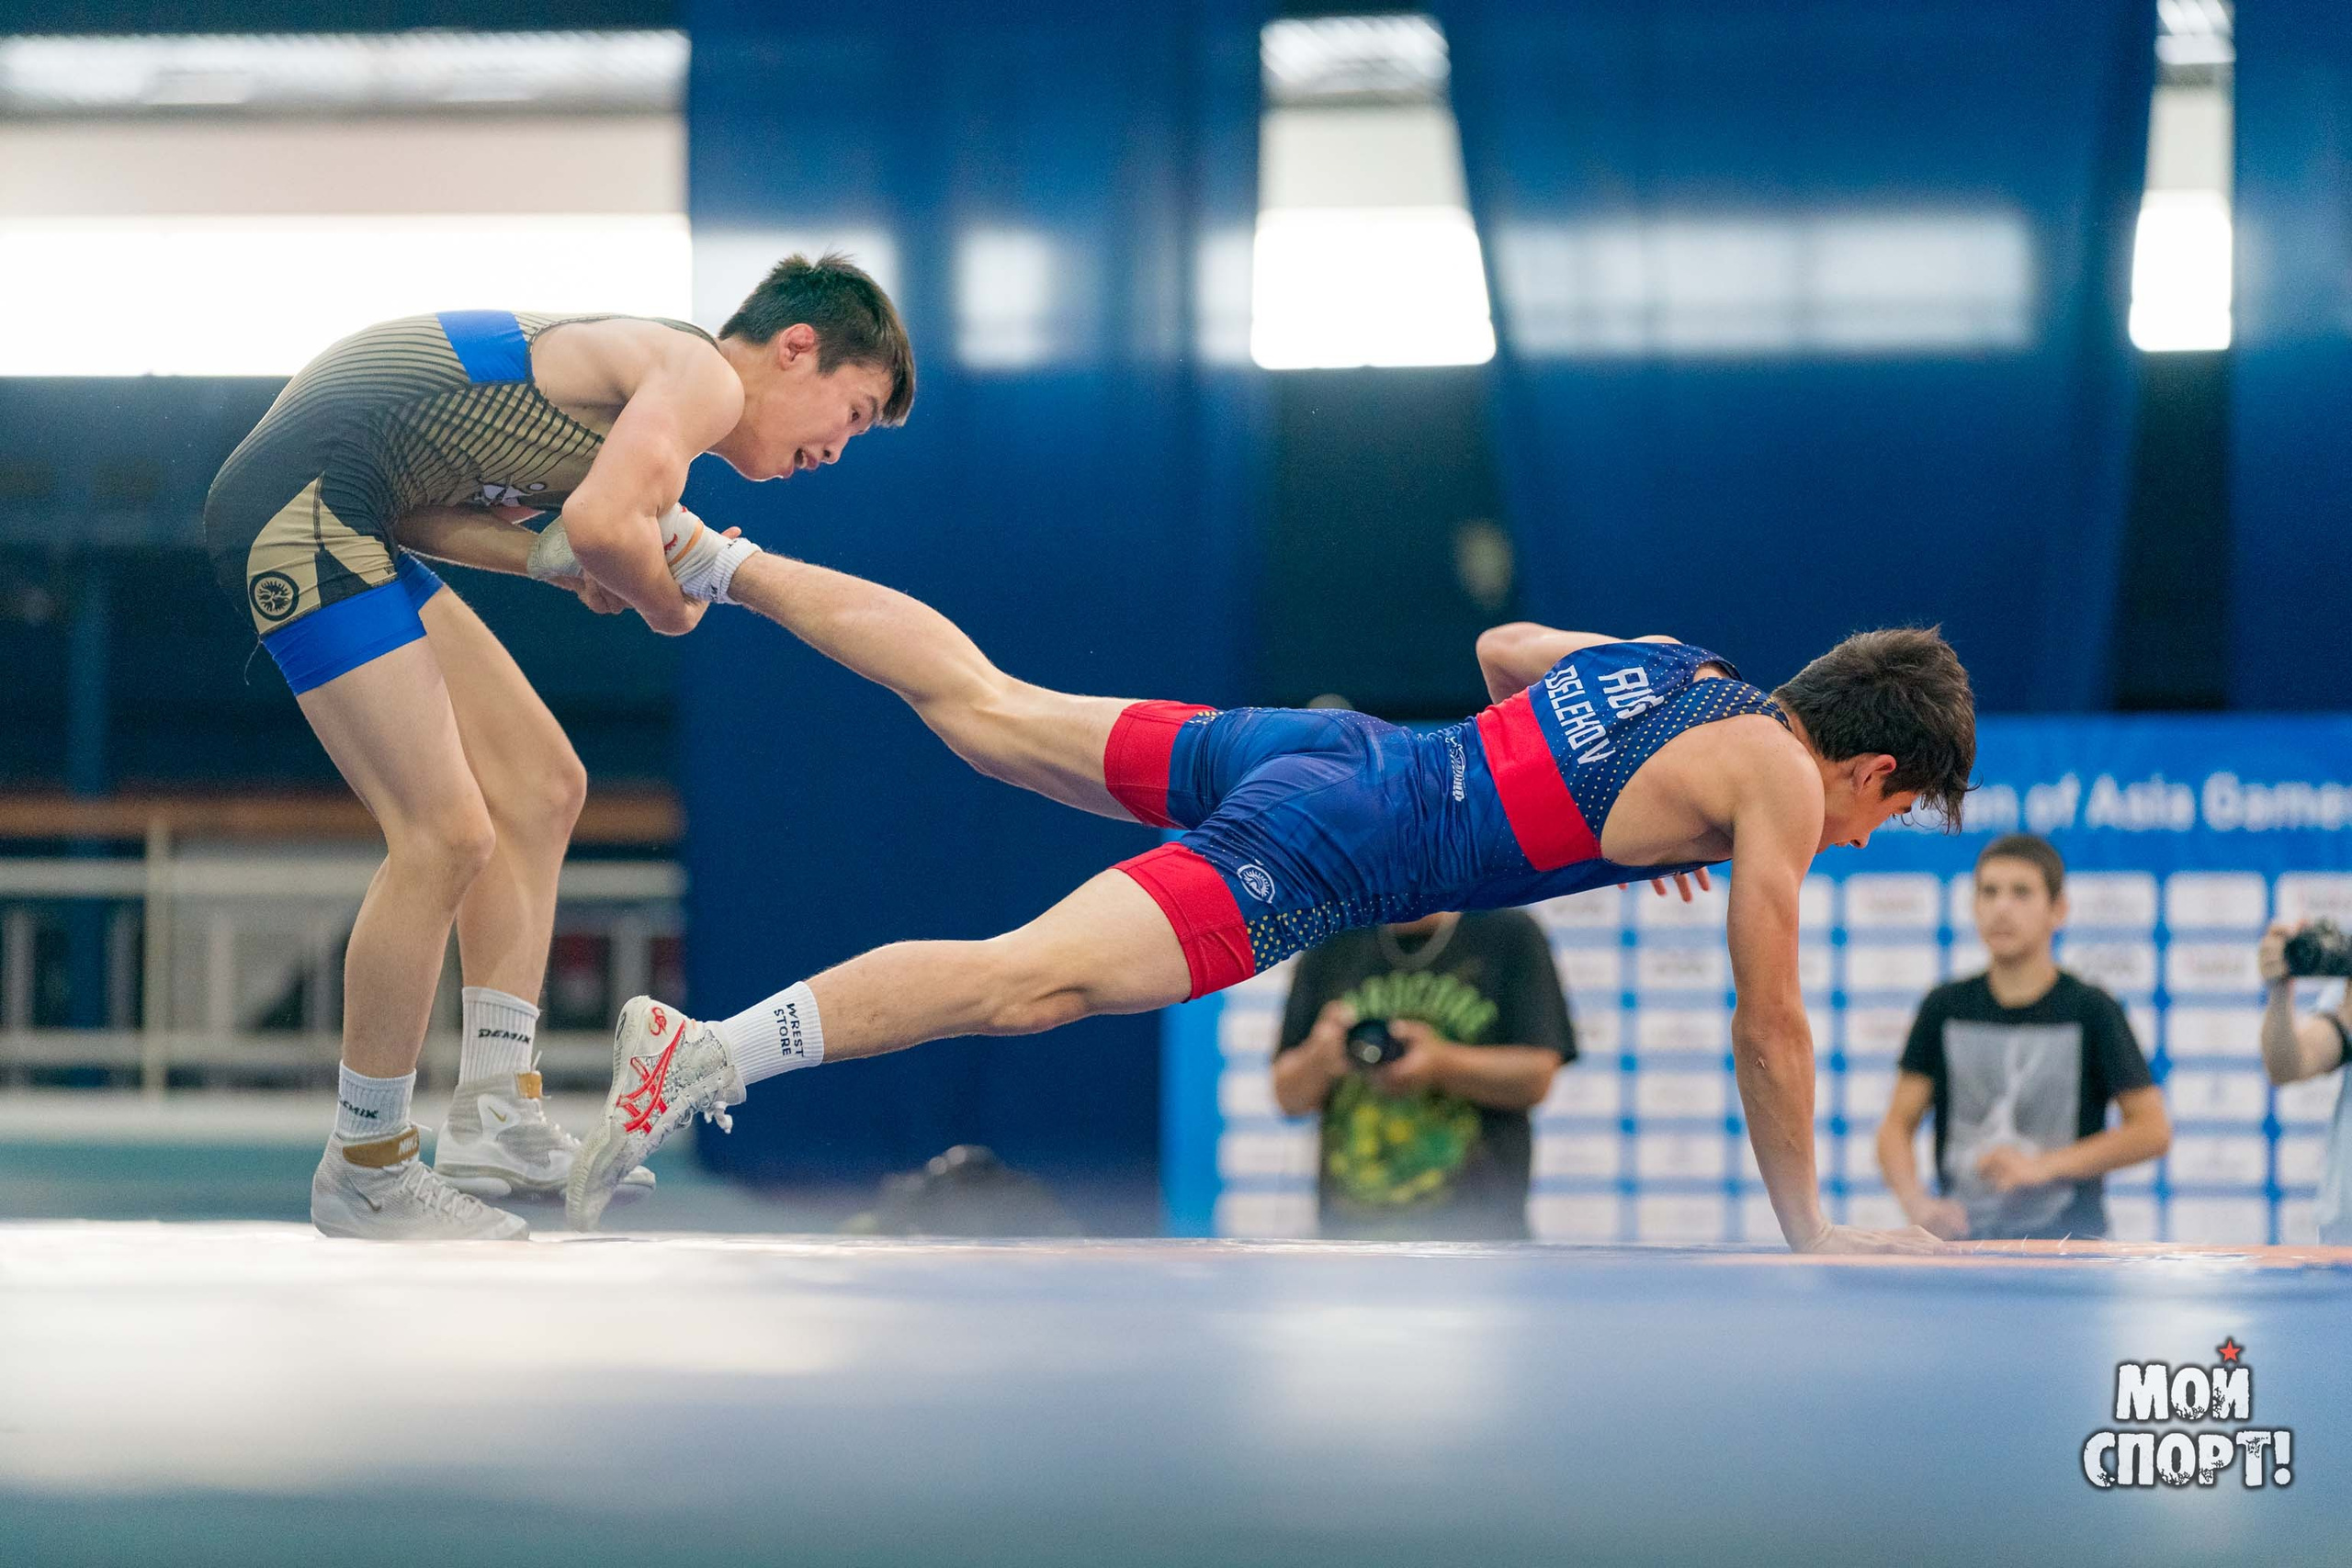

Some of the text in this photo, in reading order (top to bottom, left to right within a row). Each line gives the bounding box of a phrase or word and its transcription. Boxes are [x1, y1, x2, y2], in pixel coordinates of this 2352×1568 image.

[1544, 664, 1617, 765] DELEKOV
[2025, 773, 2081, 831] of
[2086, 773, 2196, 831] Asia
[773, 1009, 792, 1056] STORE
[786, 1002, 805, 1058] WREST
